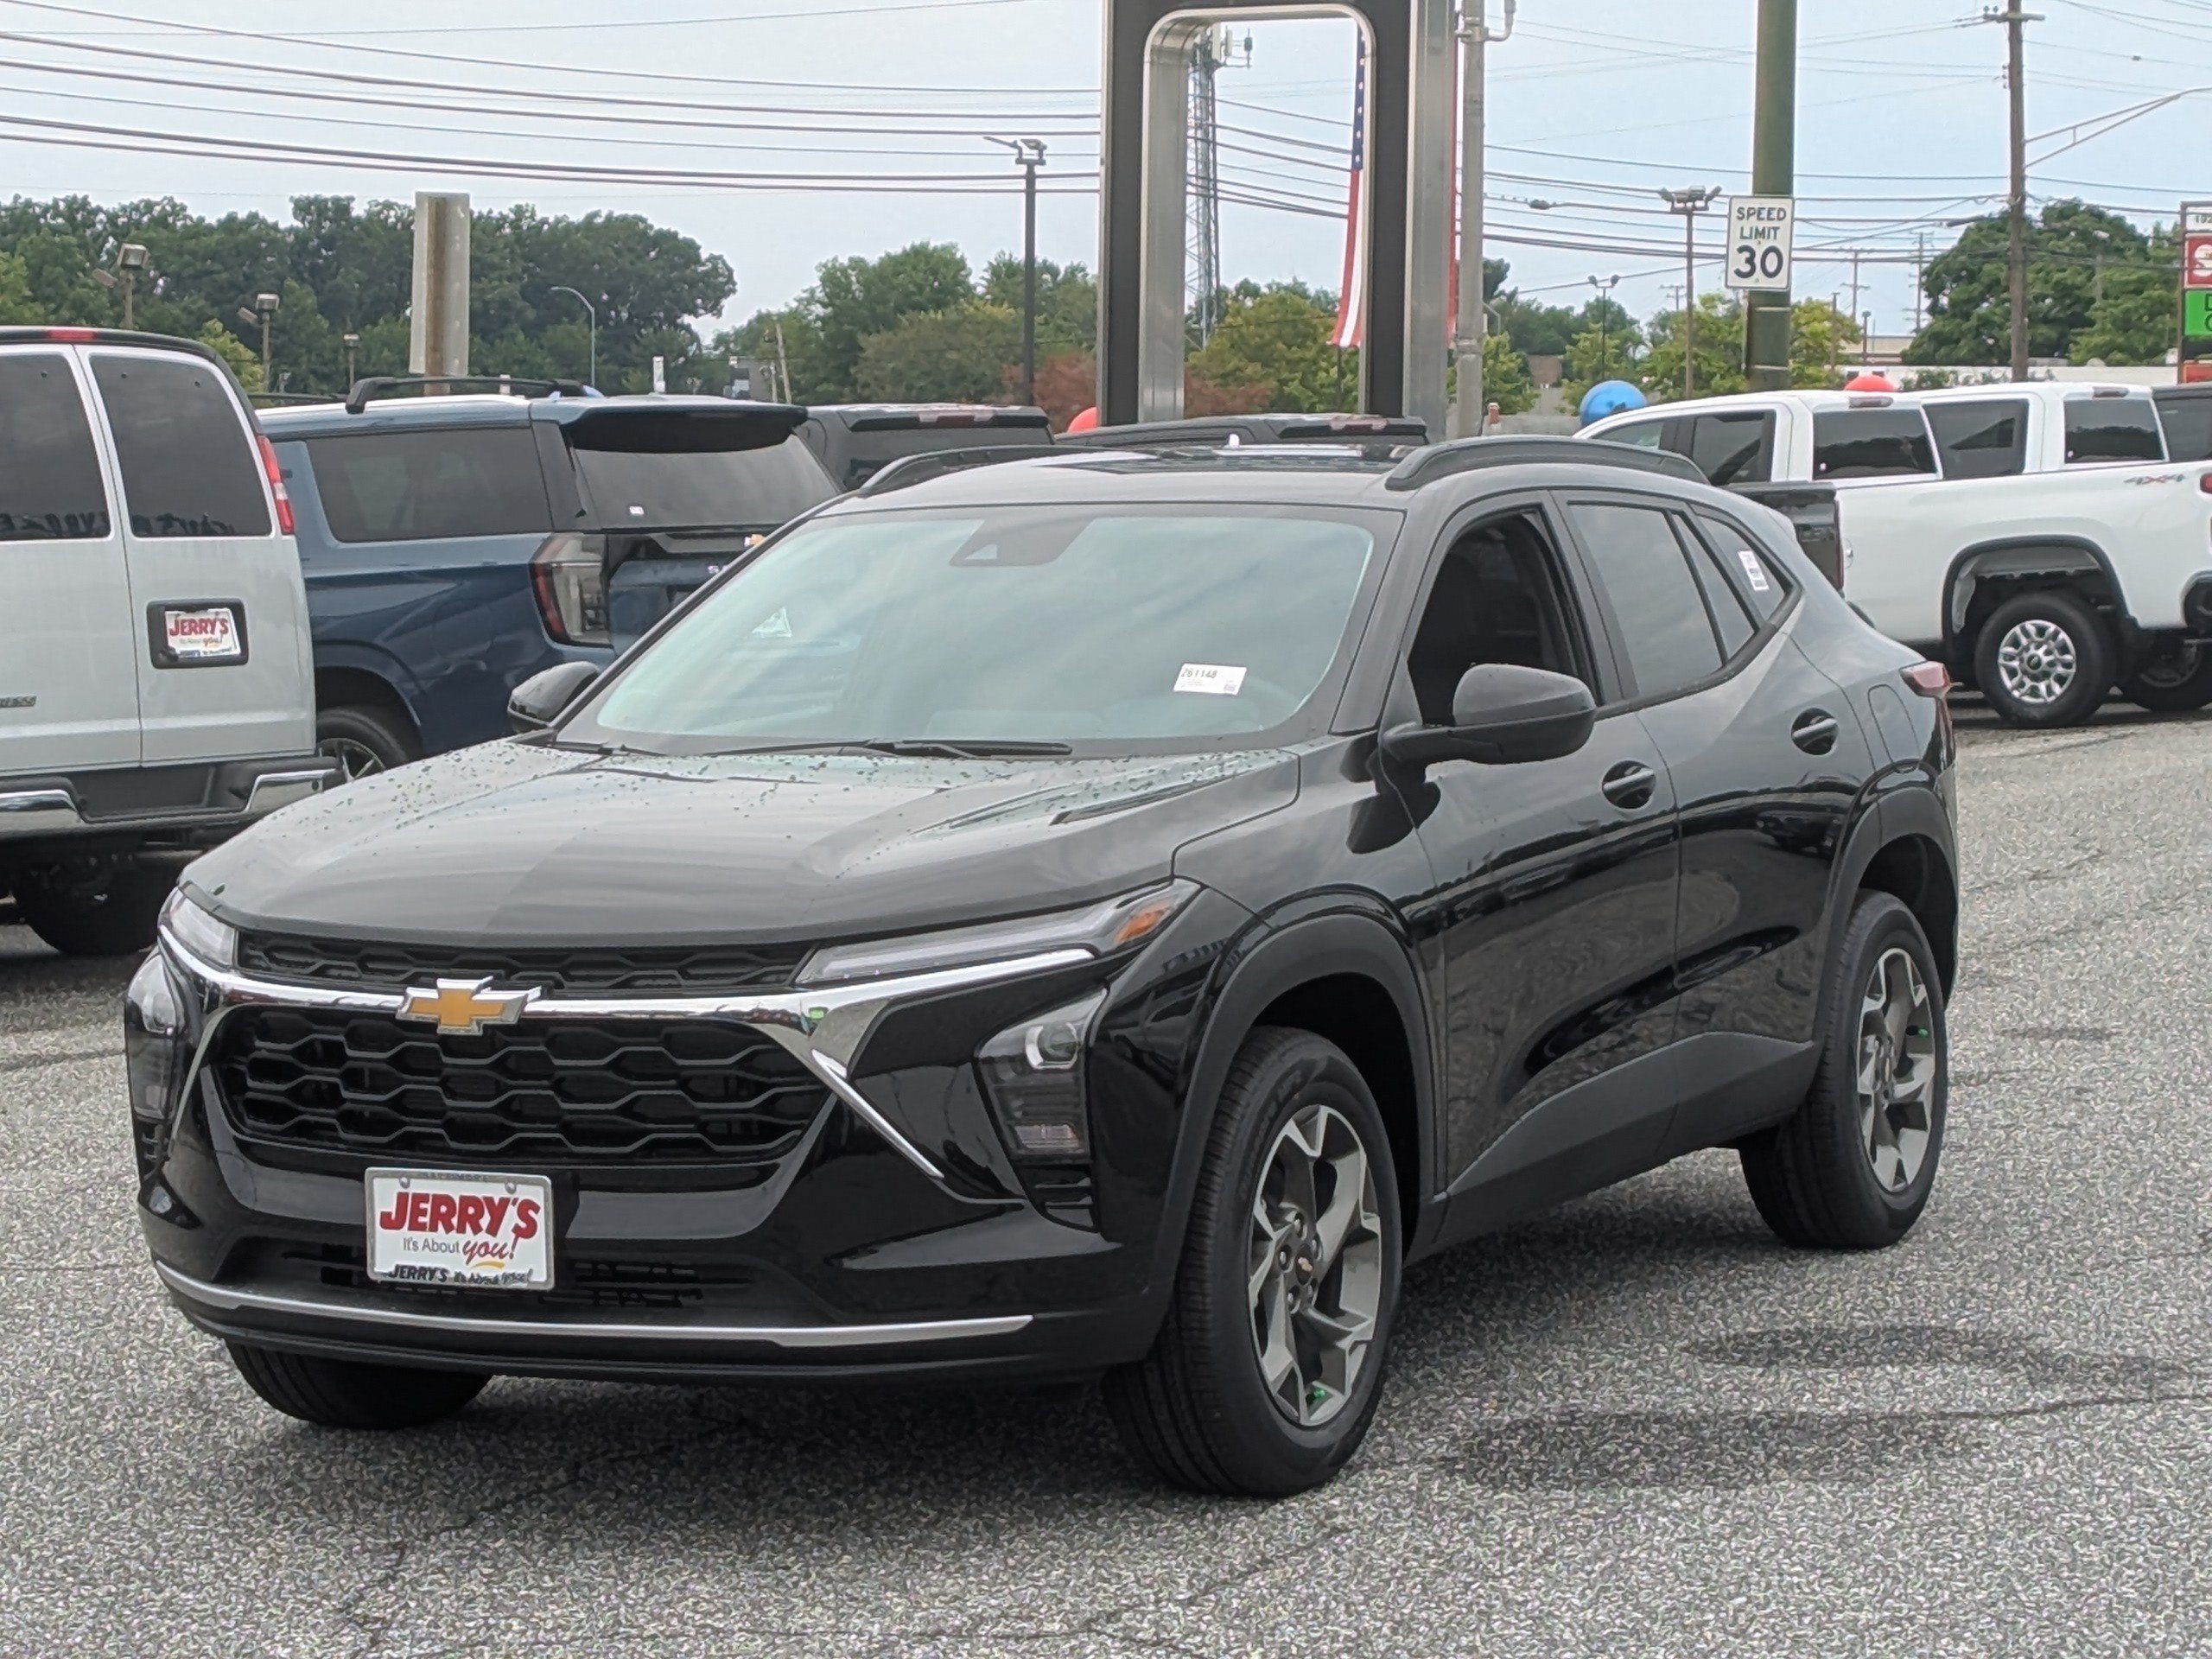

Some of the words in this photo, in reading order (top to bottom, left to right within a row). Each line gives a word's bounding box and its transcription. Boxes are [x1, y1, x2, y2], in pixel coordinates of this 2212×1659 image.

[1736, 207, 1787, 221] SPEED
[1739, 226, 1780, 239] LIMIT
[1733, 245, 1783, 278] 30
[168, 617, 229, 636] JERRY'S
[378, 1192, 541, 1239] JERRY'S
[403, 1236, 419, 1251] It's
[422, 1238, 461, 1253] About
[461, 1236, 519, 1266] you!
[388, 1264, 450, 1283] JERRY'S
